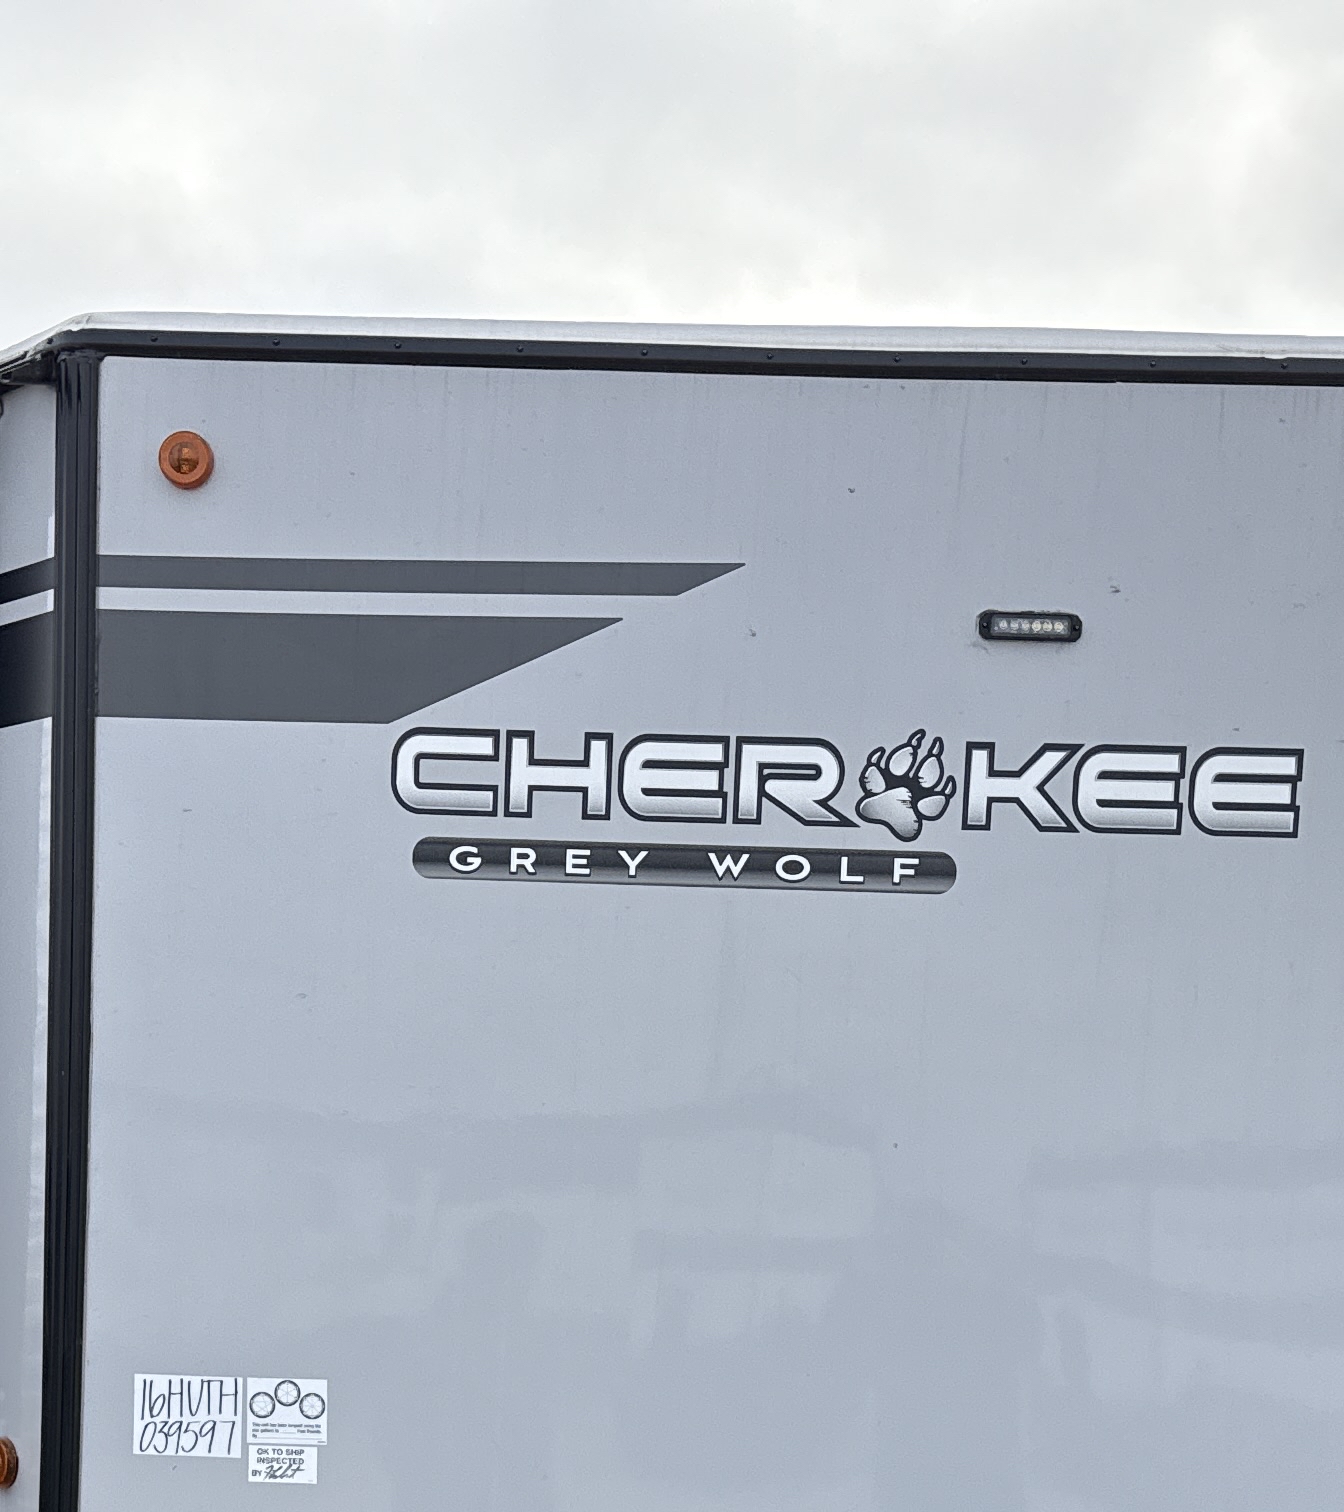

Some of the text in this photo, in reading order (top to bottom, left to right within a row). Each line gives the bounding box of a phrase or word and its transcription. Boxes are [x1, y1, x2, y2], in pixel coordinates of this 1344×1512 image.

[447, 844, 922, 885] GREY WOLF
[141, 1378, 239, 1420] 16HUTH
[139, 1420, 236, 1455] 039597
[272, 1448, 283, 1456] TO
[285, 1448, 305, 1456] SHIP
[256, 1457, 305, 1465] INSPECTED
